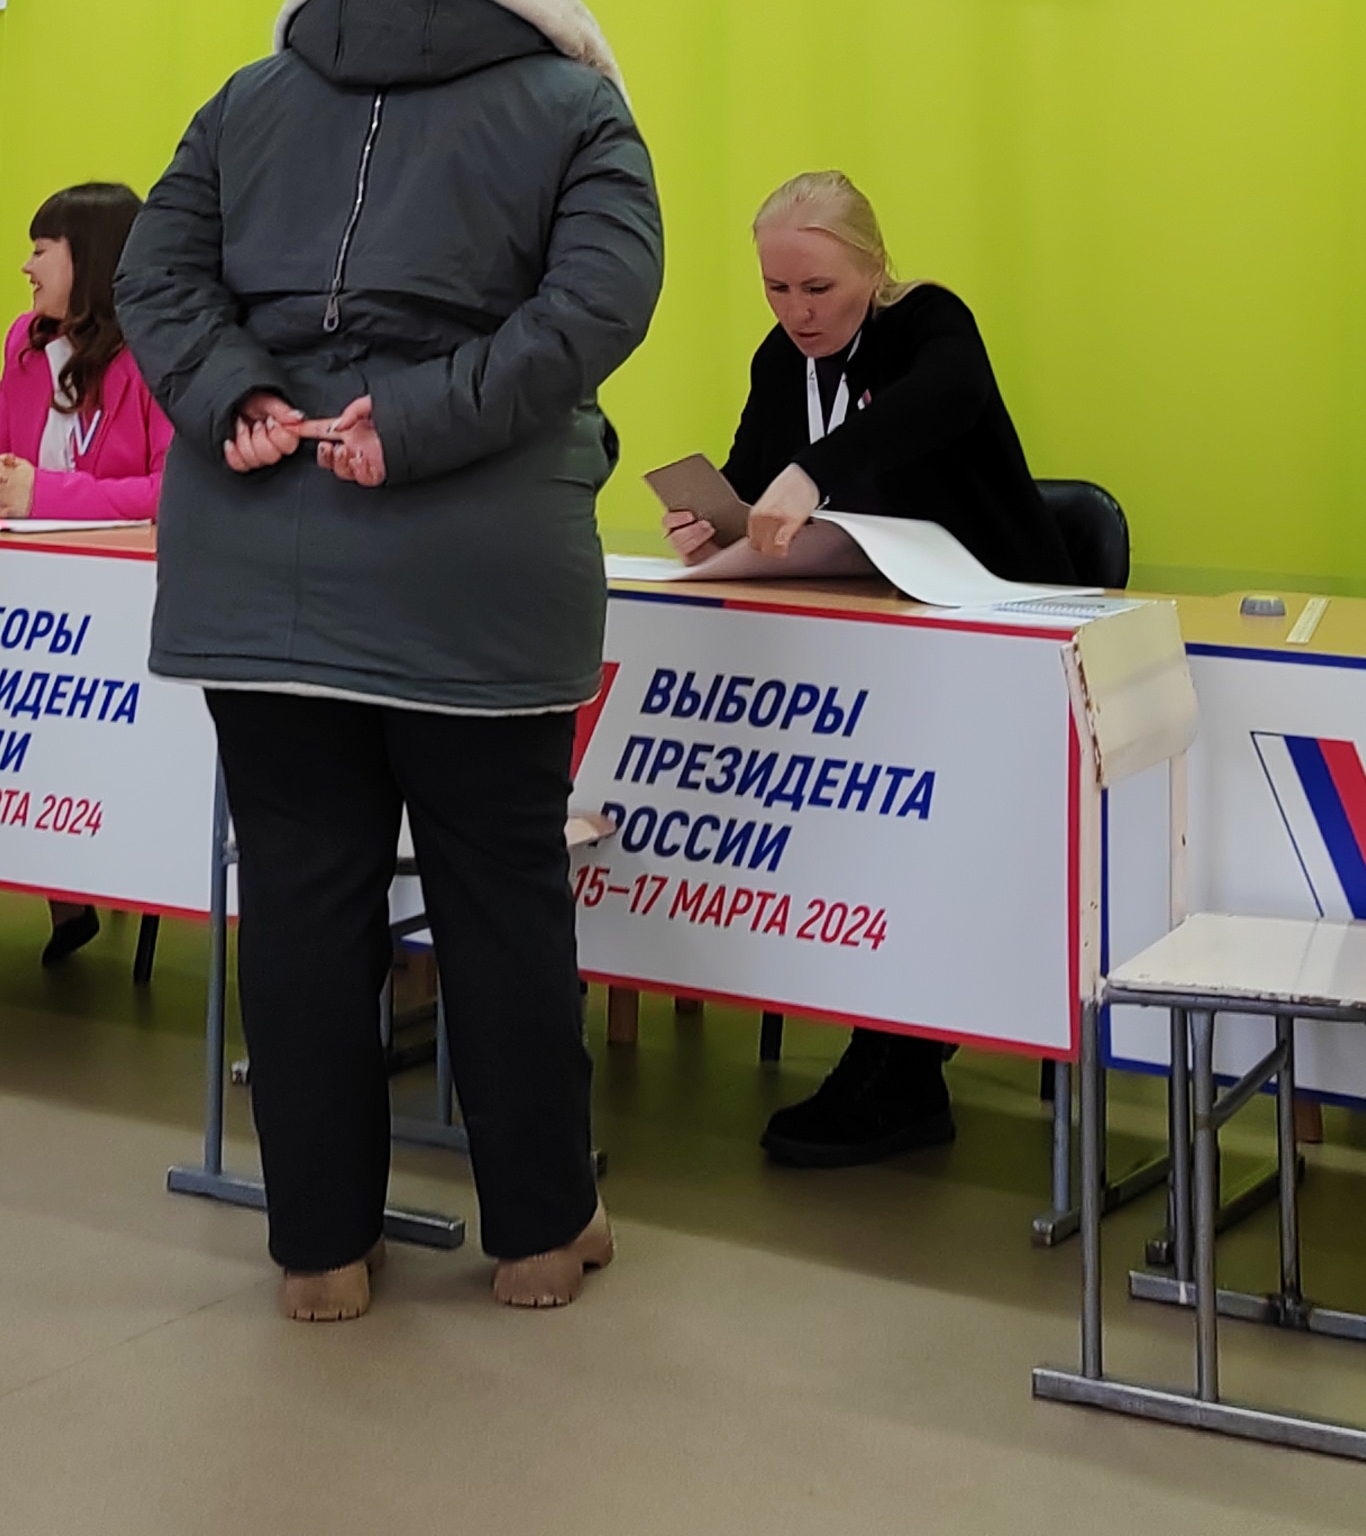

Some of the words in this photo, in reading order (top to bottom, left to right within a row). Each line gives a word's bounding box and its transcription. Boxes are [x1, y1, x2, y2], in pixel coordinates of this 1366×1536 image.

[638, 667, 870, 738] ВЫБОРЫ
[612, 734, 937, 821] ПРЕЗИДЕНТА
[33, 793, 103, 837] 2024
[668, 878, 791, 937] МАРТА
[794, 897, 888, 953] 2024
